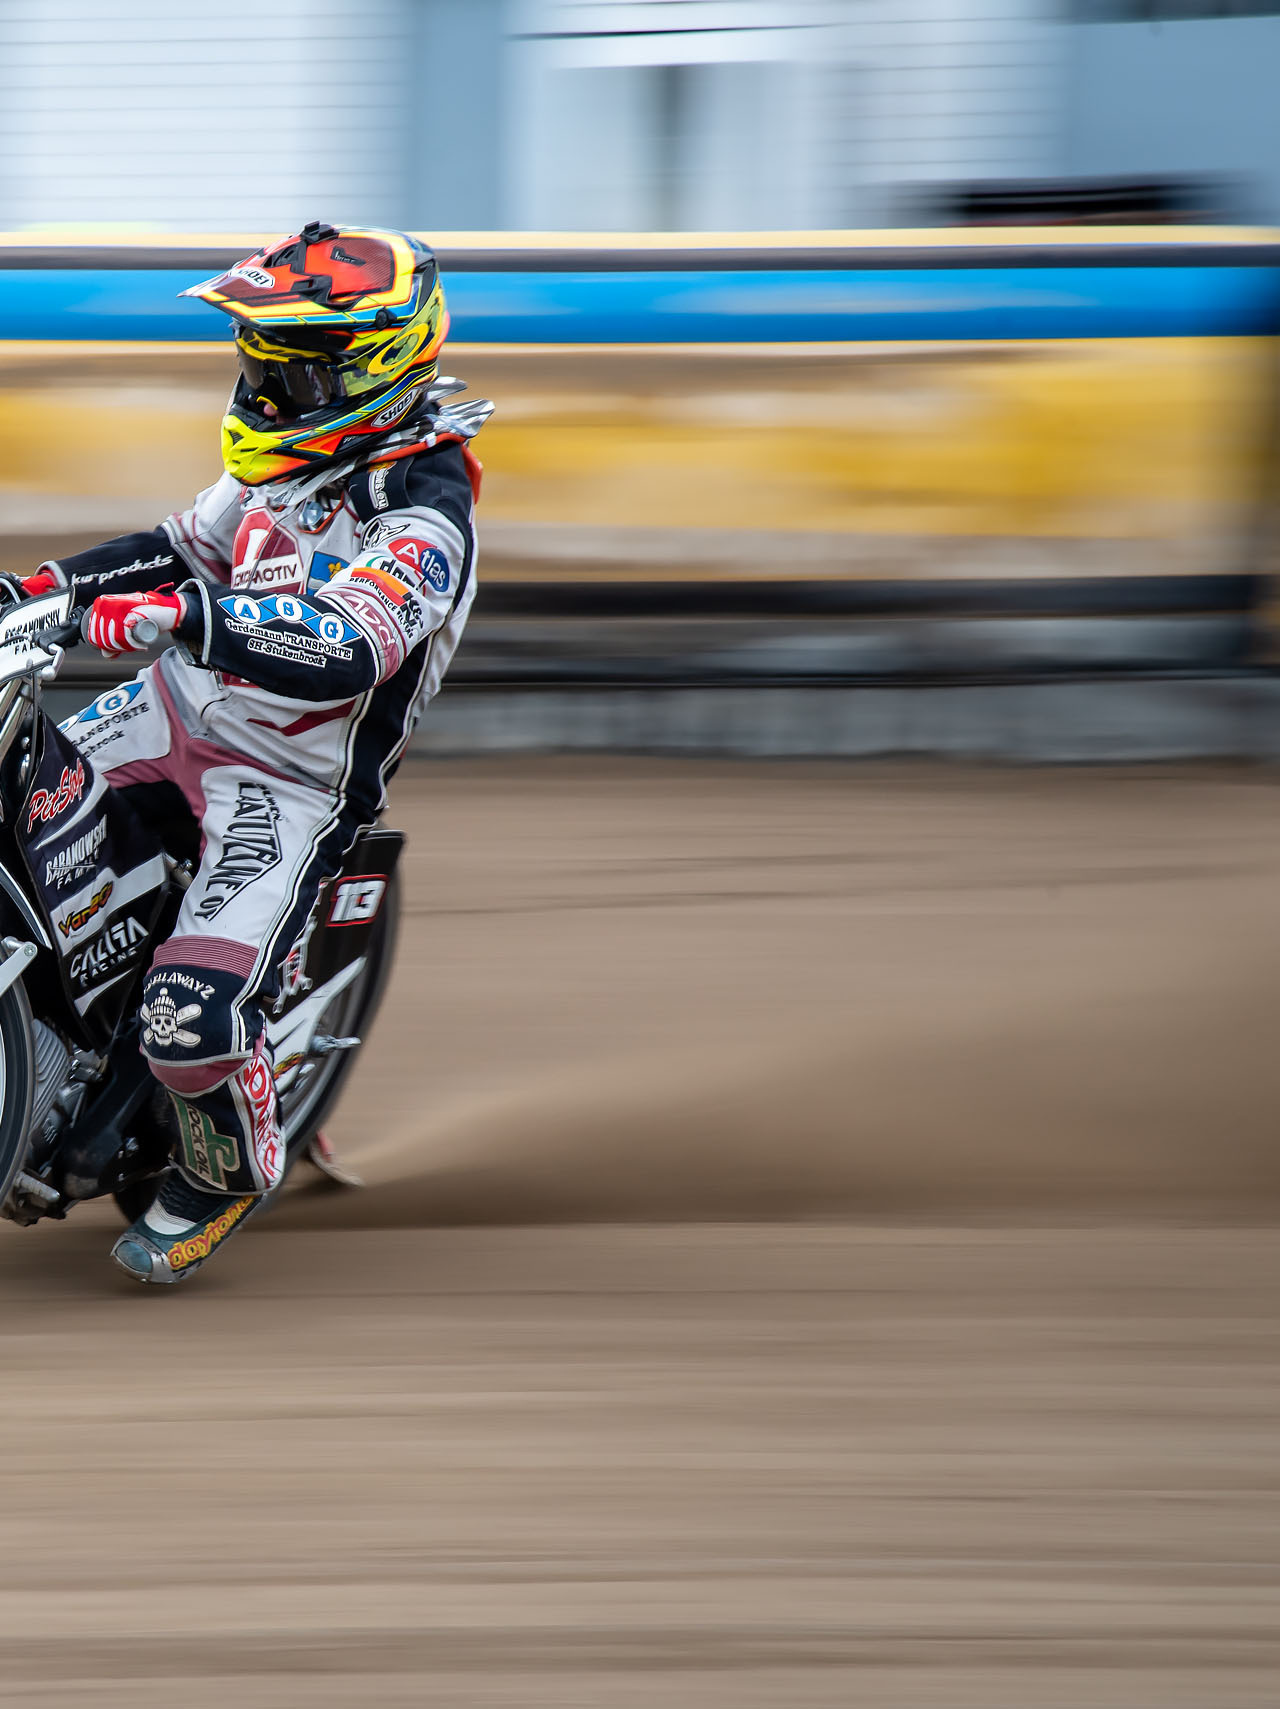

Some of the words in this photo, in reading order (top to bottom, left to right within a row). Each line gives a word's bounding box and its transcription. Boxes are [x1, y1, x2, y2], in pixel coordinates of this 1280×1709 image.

[379, 391, 414, 424] SHOEI
[396, 542, 447, 588] Atlas
[349, 577, 398, 612] PERFORMANCE
[238, 603, 257, 620] A
[282, 601, 295, 617] S
[324, 621, 339, 639] G
[284, 632, 352, 659] TRANSPORTE
